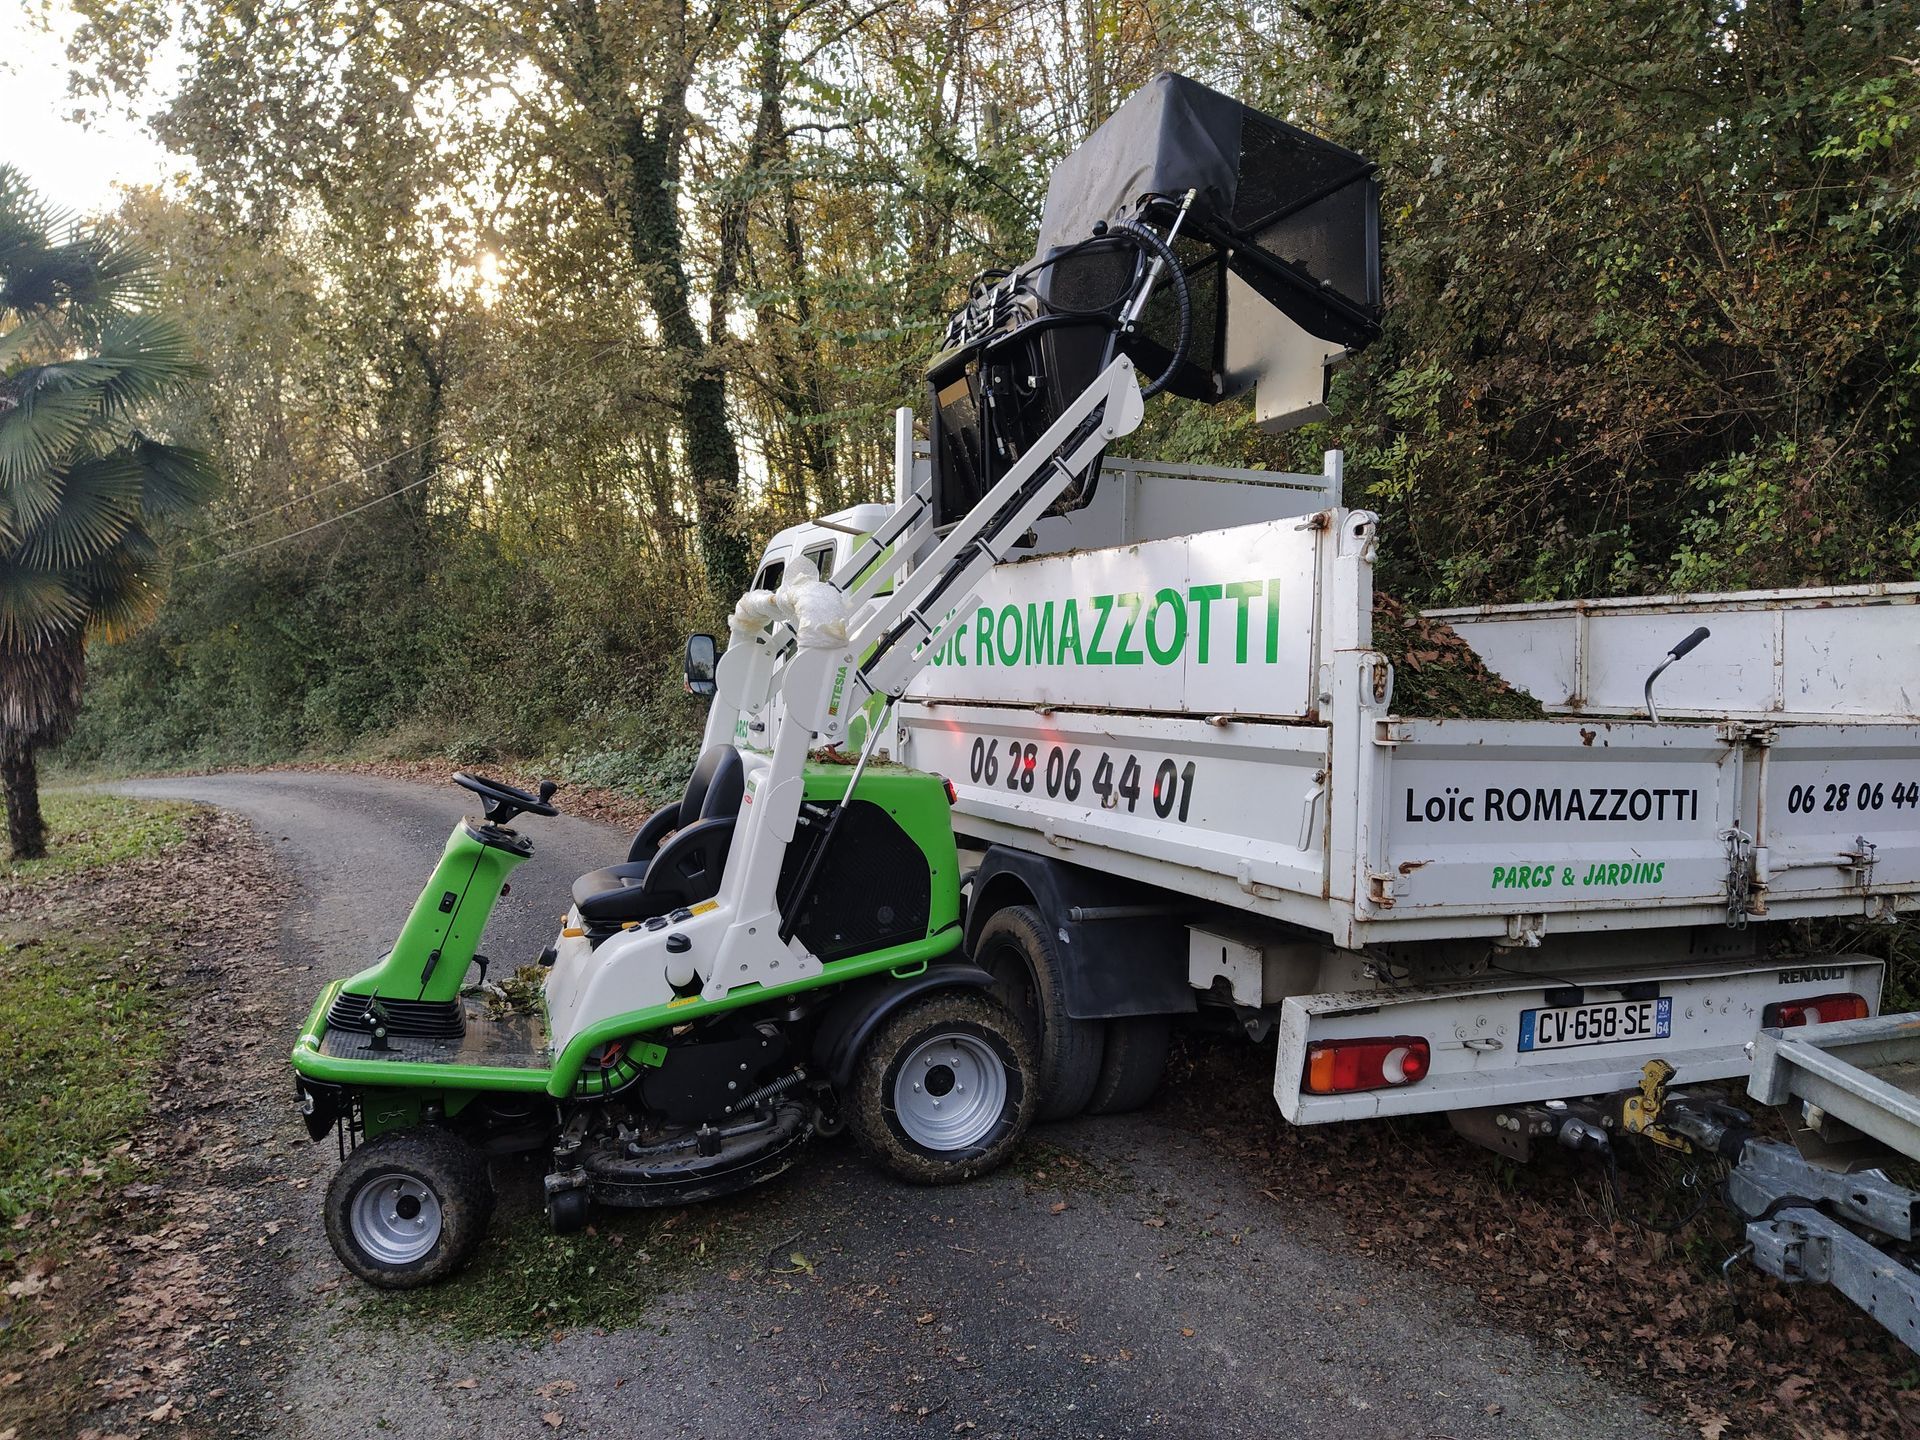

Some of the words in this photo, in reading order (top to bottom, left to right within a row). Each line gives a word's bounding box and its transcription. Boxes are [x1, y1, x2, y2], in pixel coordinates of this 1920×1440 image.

[976, 578, 1281, 666] ROMAZZOTTI
[830, 666, 848, 709] ETESIA
[970, 737, 998, 786] 06
[1007, 741, 1038, 793] 28
[1046, 746, 1082, 802] 06
[1092, 752, 1142, 813] 44
[1153, 758, 1196, 823] 01
[1406, 787, 1475, 822] Loïc
[1485, 787, 1698, 822] ROMAZZOTTI
[1788, 784, 1816, 814] 06
[1823, 783, 1851, 812] 28
[1857, 782, 1884, 810] 06
[1891, 781, 1919, 809] 44
[1491, 865, 1555, 890] PARCS
[1561, 867, 1576, 887] &
[1582, 861, 1666, 887] JARDINS
[1778, 967, 1847, 985] RENAULT
[1524, 1034, 1530, 1044] F
[1538, 1003, 1652, 1044] CV-658-SE
[1656, 1021, 1669, 1035] 64
